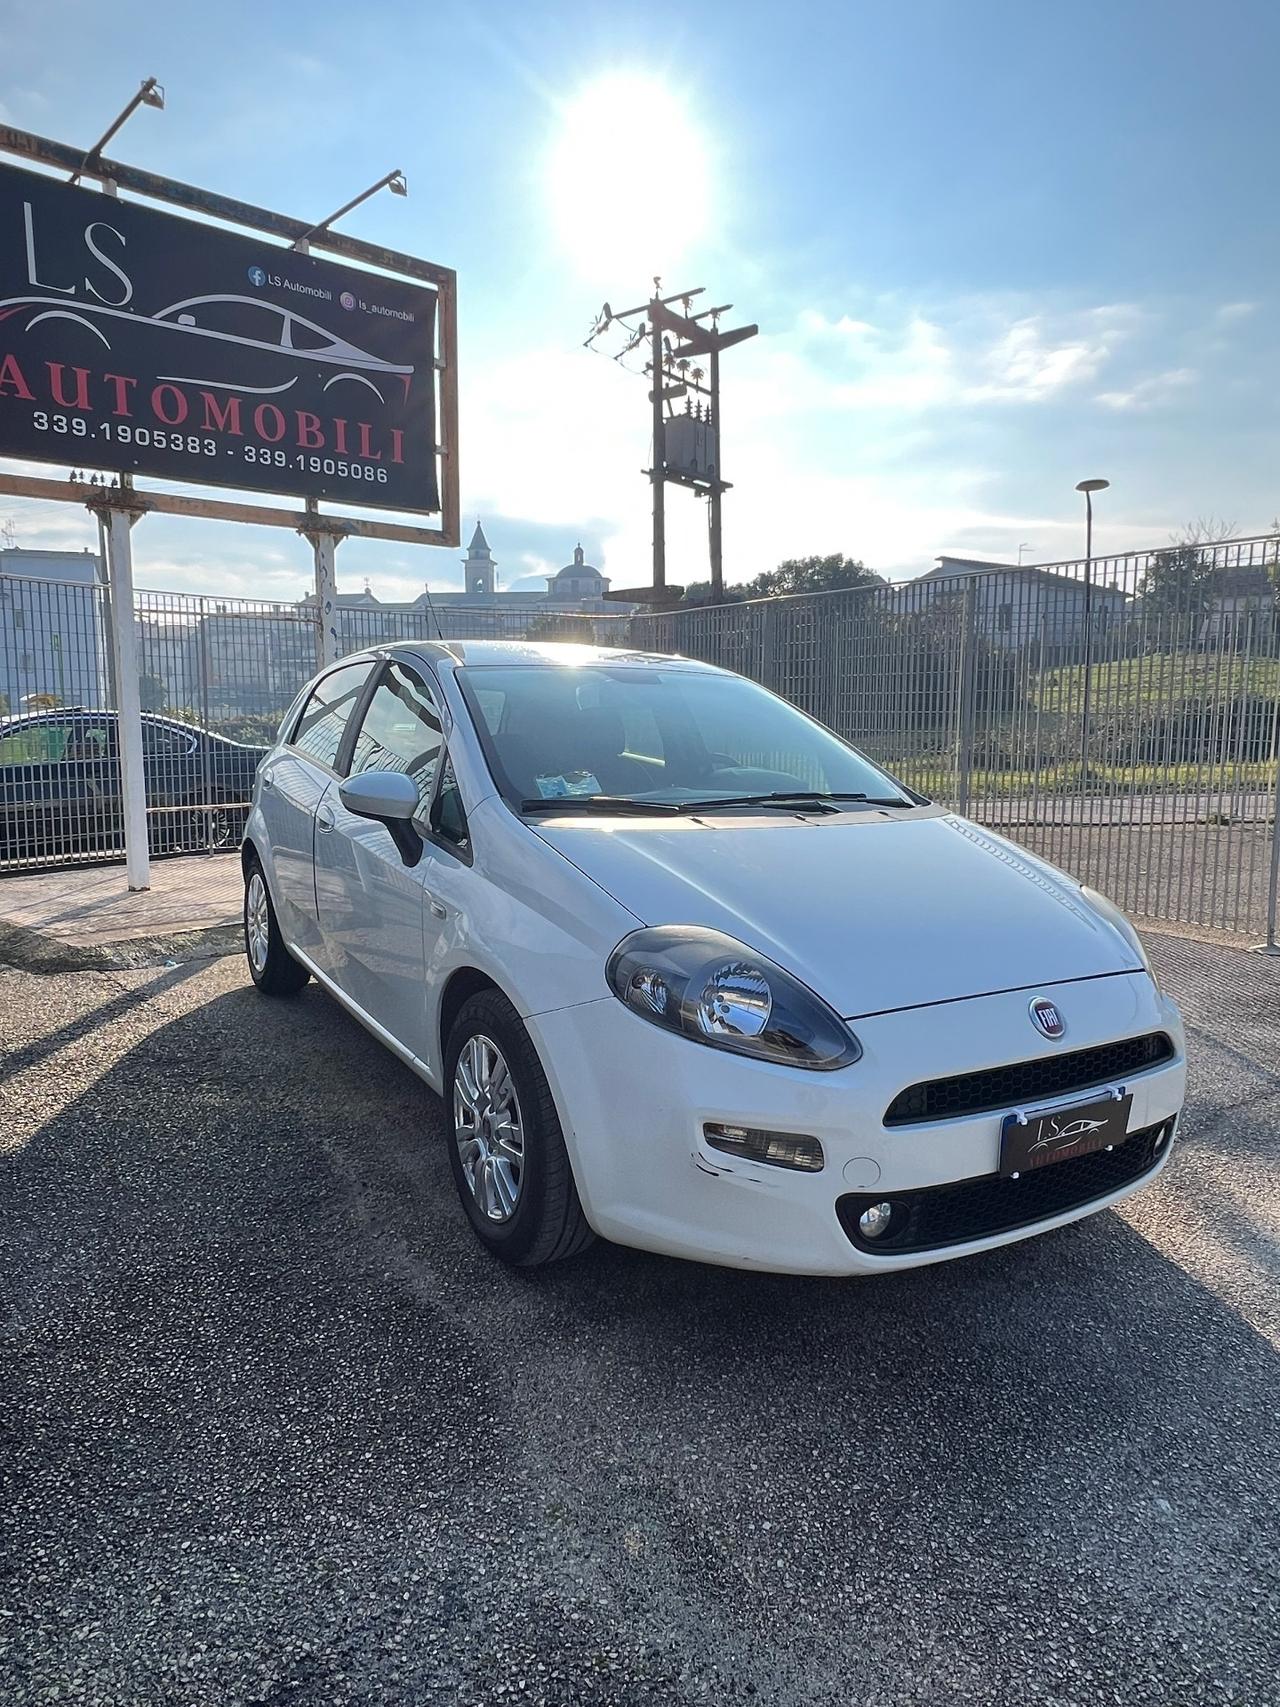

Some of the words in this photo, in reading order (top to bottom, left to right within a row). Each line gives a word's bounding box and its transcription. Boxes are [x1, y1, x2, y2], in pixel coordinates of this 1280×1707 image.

[23, 201, 134, 306] LS
[267, 274, 282, 287] LS
[283, 279, 332, 301] Automobili
[359, 300, 415, 323] ls_automobili
[0, 354, 405, 464] AUTOMOBILI
[33, 411, 217, 456] 339.1905383
[244, 445, 389, 484] 339.1905086
[1037, 1007, 1061, 1028] FIAT
